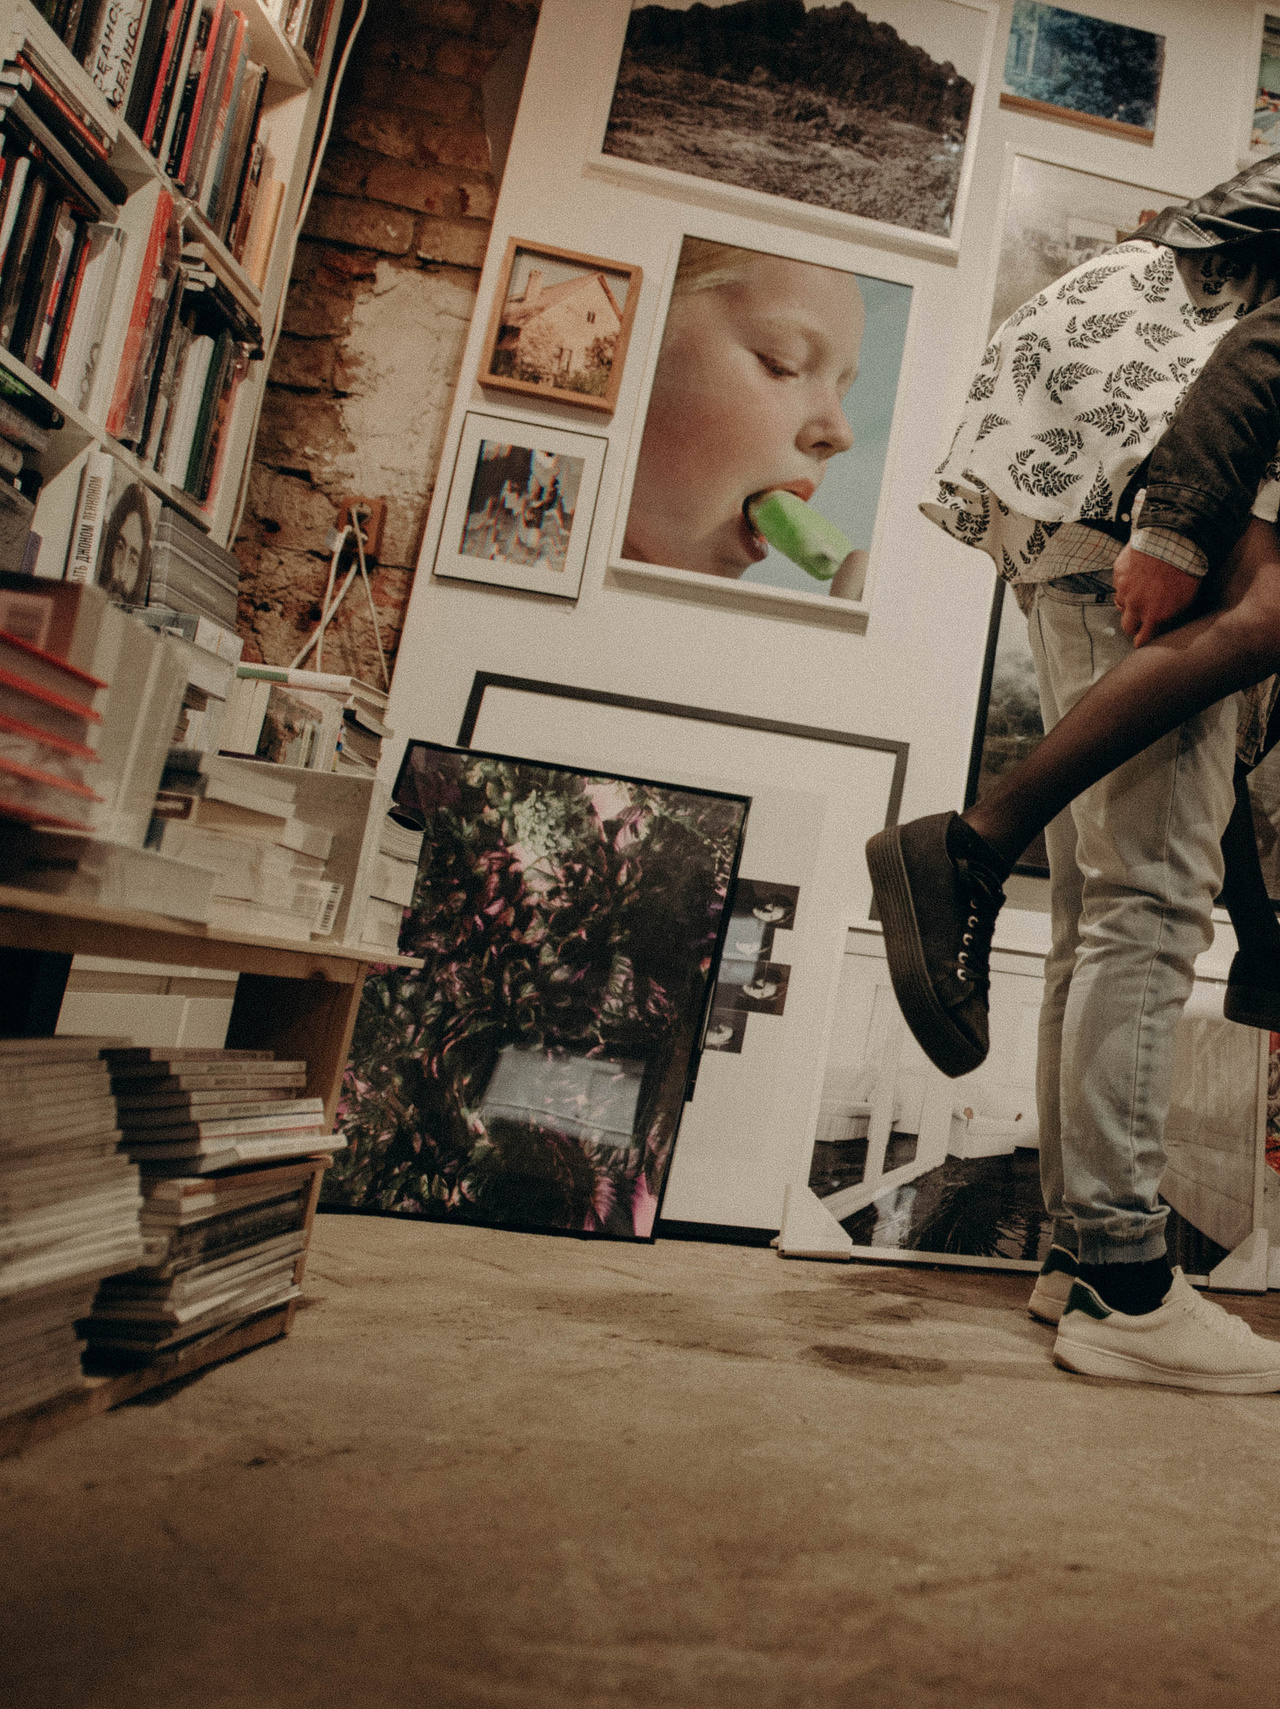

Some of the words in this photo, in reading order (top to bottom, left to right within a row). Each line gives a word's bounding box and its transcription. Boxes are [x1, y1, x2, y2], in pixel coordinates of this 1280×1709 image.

[112, 21, 137, 103] СЕАНС
[82, 475, 102, 522] ЛЕННОНОМ
[75, 523, 94, 563] ДЖОНОМ
[72, 565, 88, 581] ЫТЬ
